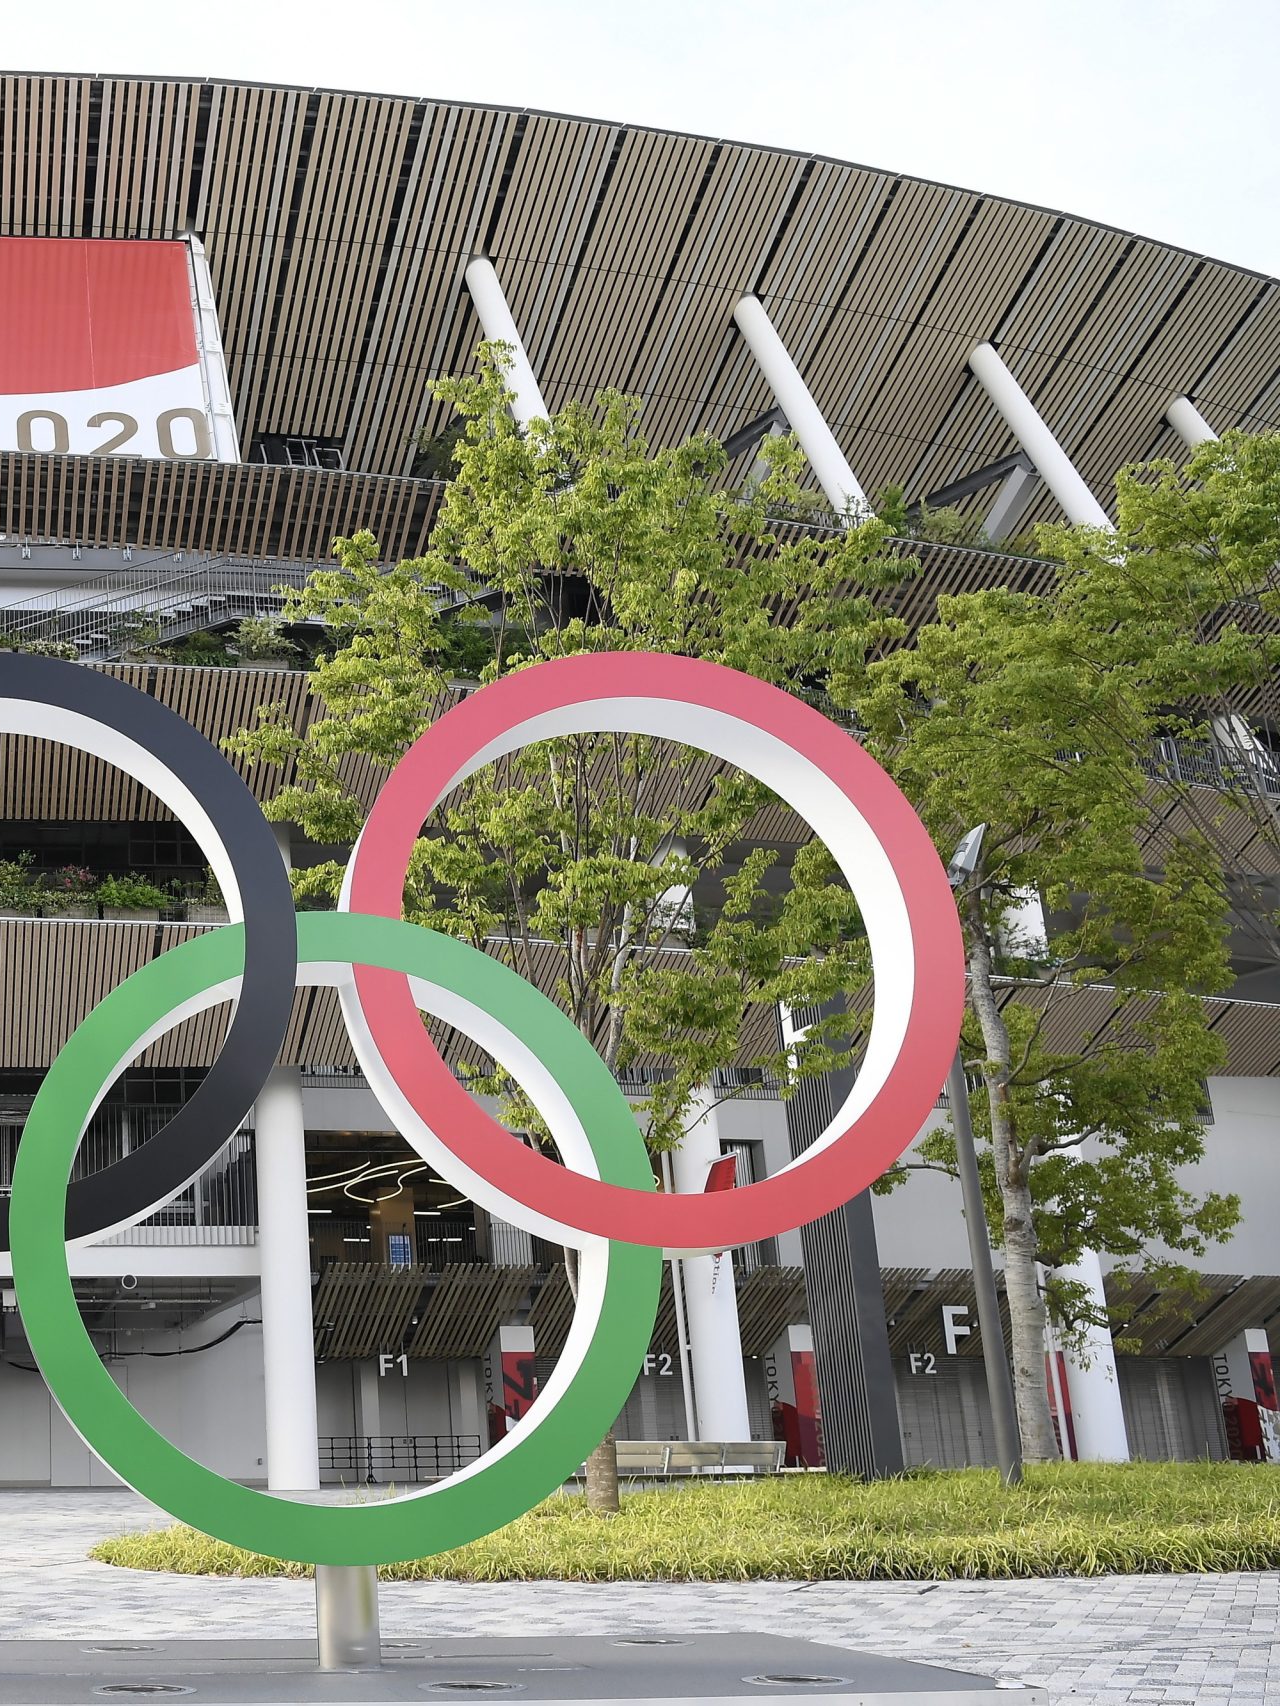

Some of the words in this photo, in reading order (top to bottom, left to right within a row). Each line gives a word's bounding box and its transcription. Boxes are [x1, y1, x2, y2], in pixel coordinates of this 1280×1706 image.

[942, 1305, 971, 1355] F
[379, 1354, 408, 1377] F1
[643, 1353, 673, 1376] F2
[909, 1353, 937, 1374] F2
